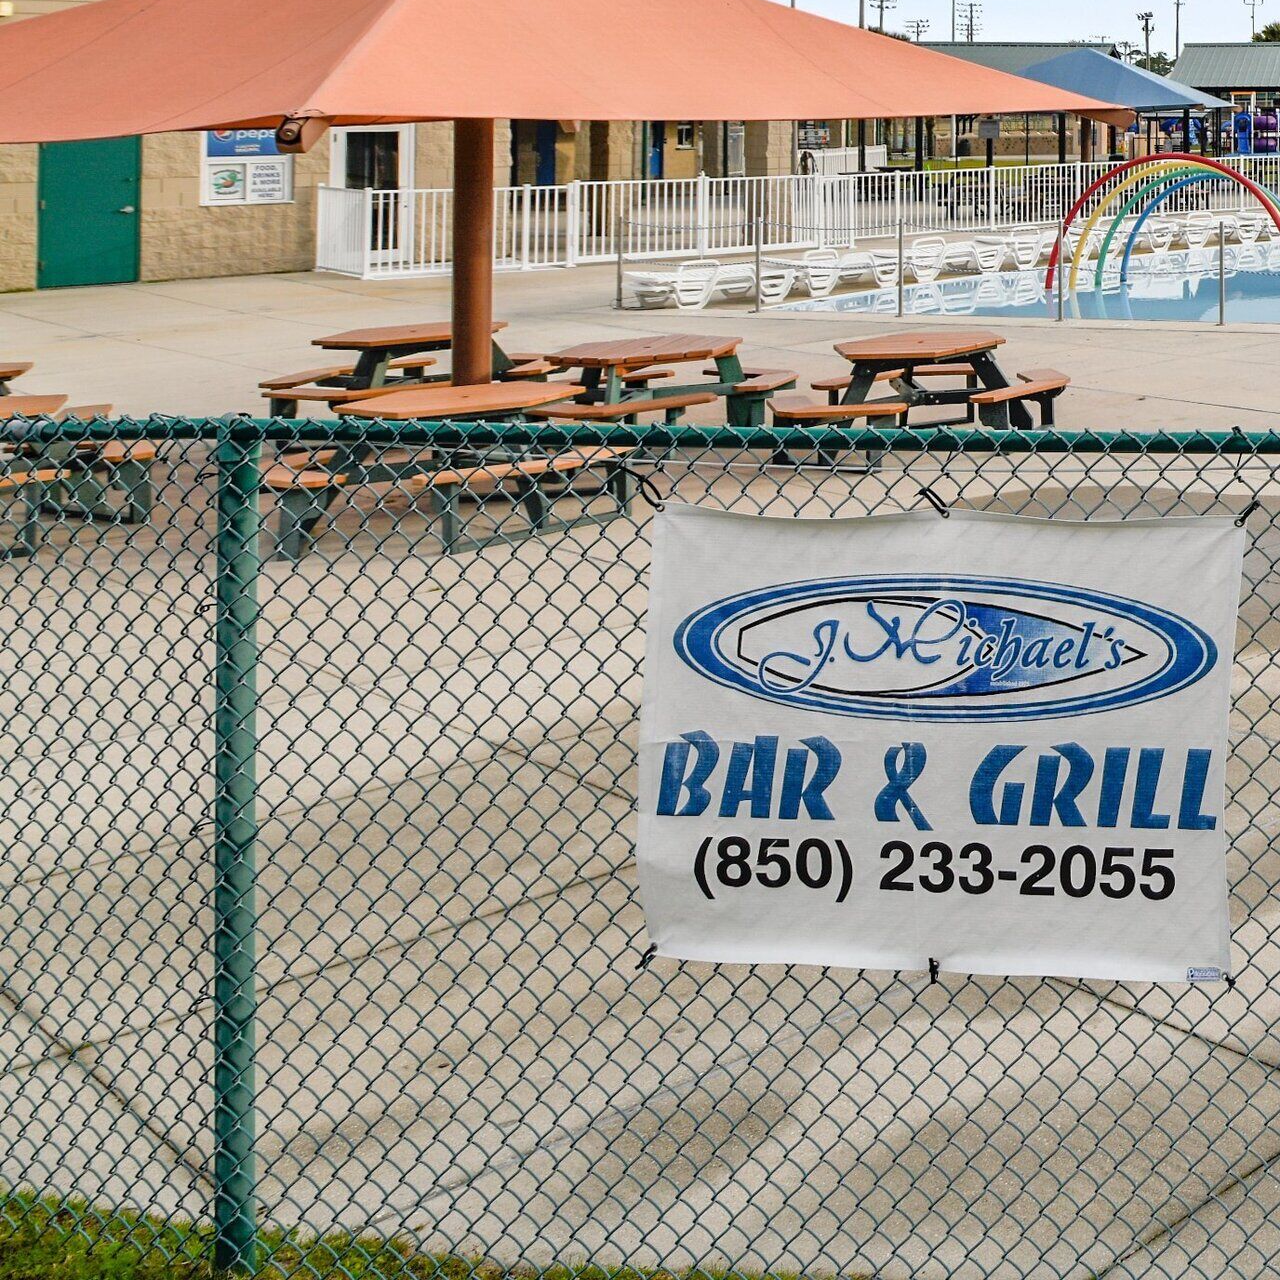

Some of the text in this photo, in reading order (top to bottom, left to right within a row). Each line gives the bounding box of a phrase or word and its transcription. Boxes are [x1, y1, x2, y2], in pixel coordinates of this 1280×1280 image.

[236, 129, 276, 140] peps
[844, 598, 1126, 681] Michael's
[656, 729, 1217, 831] BAR & GRILL
[693, 835, 1176, 903] (850) 233-2055
